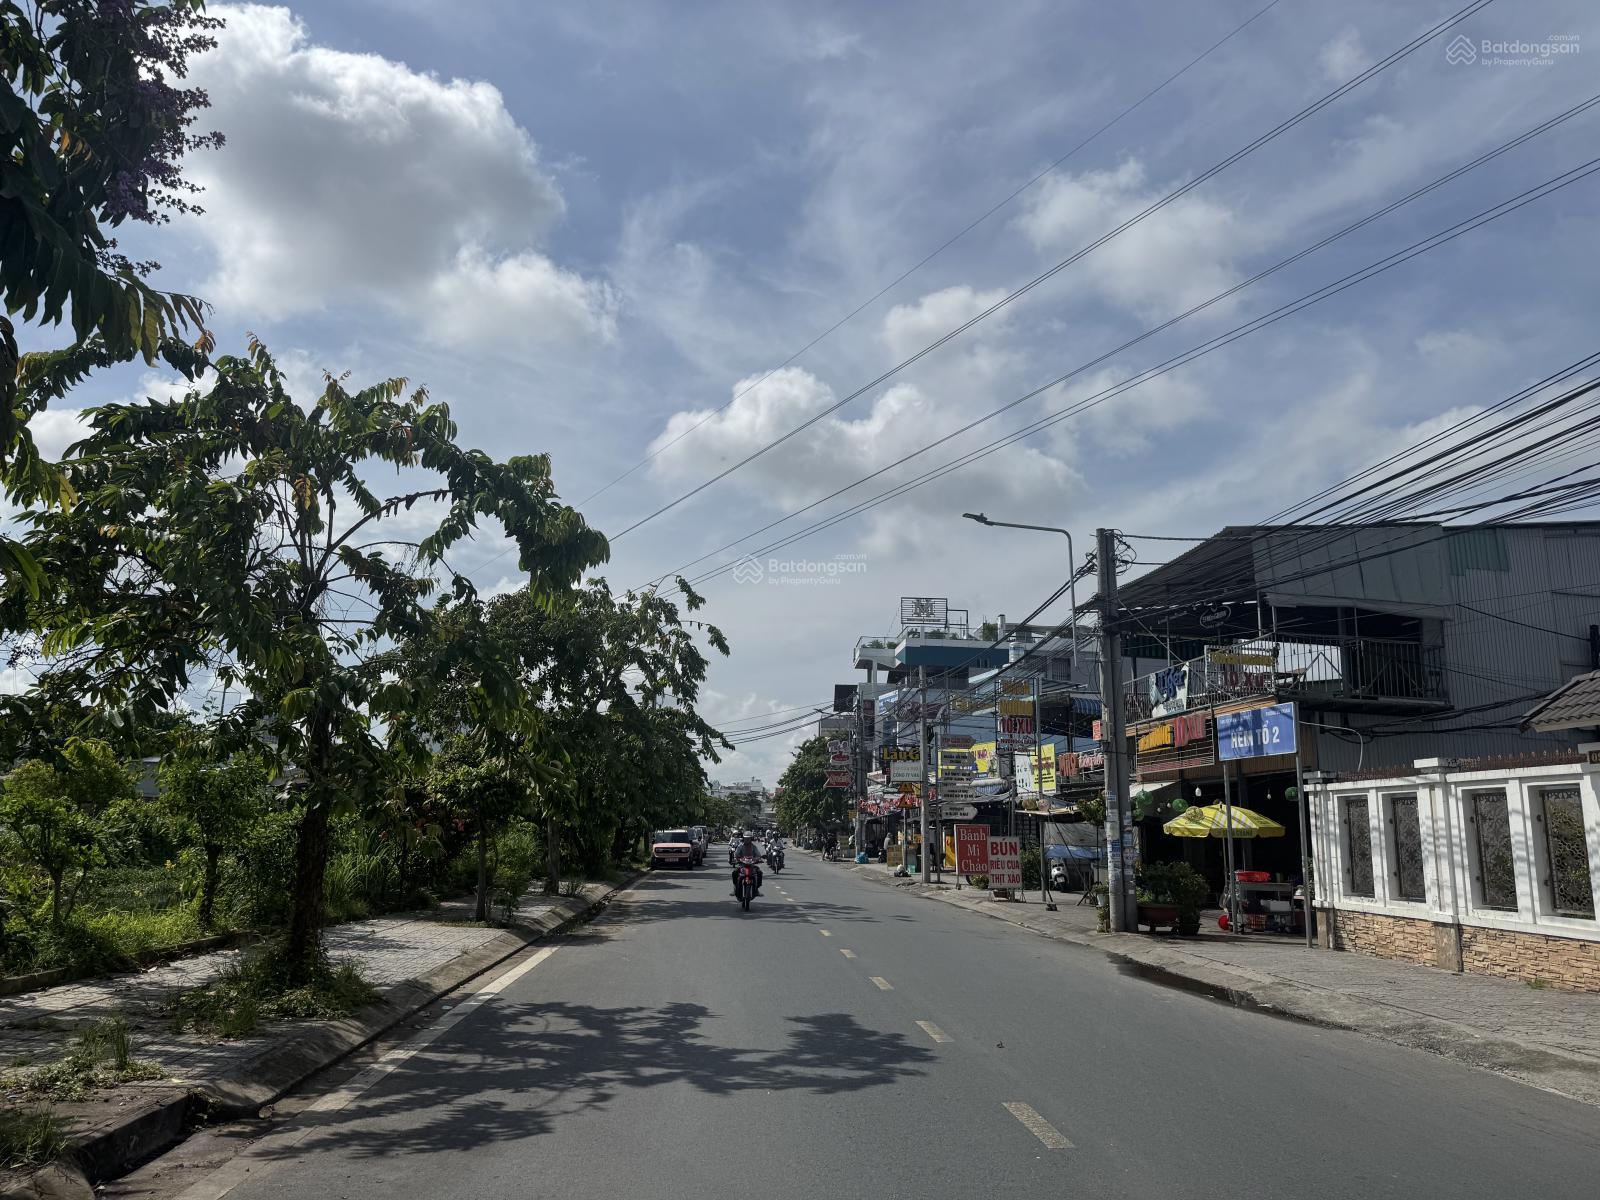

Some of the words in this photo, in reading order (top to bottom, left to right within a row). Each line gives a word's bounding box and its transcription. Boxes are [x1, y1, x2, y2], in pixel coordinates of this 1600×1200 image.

[1272, 726, 1280, 744] 2
[960, 827, 986, 840] Bánh
[990, 838, 1018, 856] BÚN
[990, 857, 1005, 870] RIÊU
[1007, 860, 1020, 870] CUA
[990, 873, 1005, 885] THỊT
